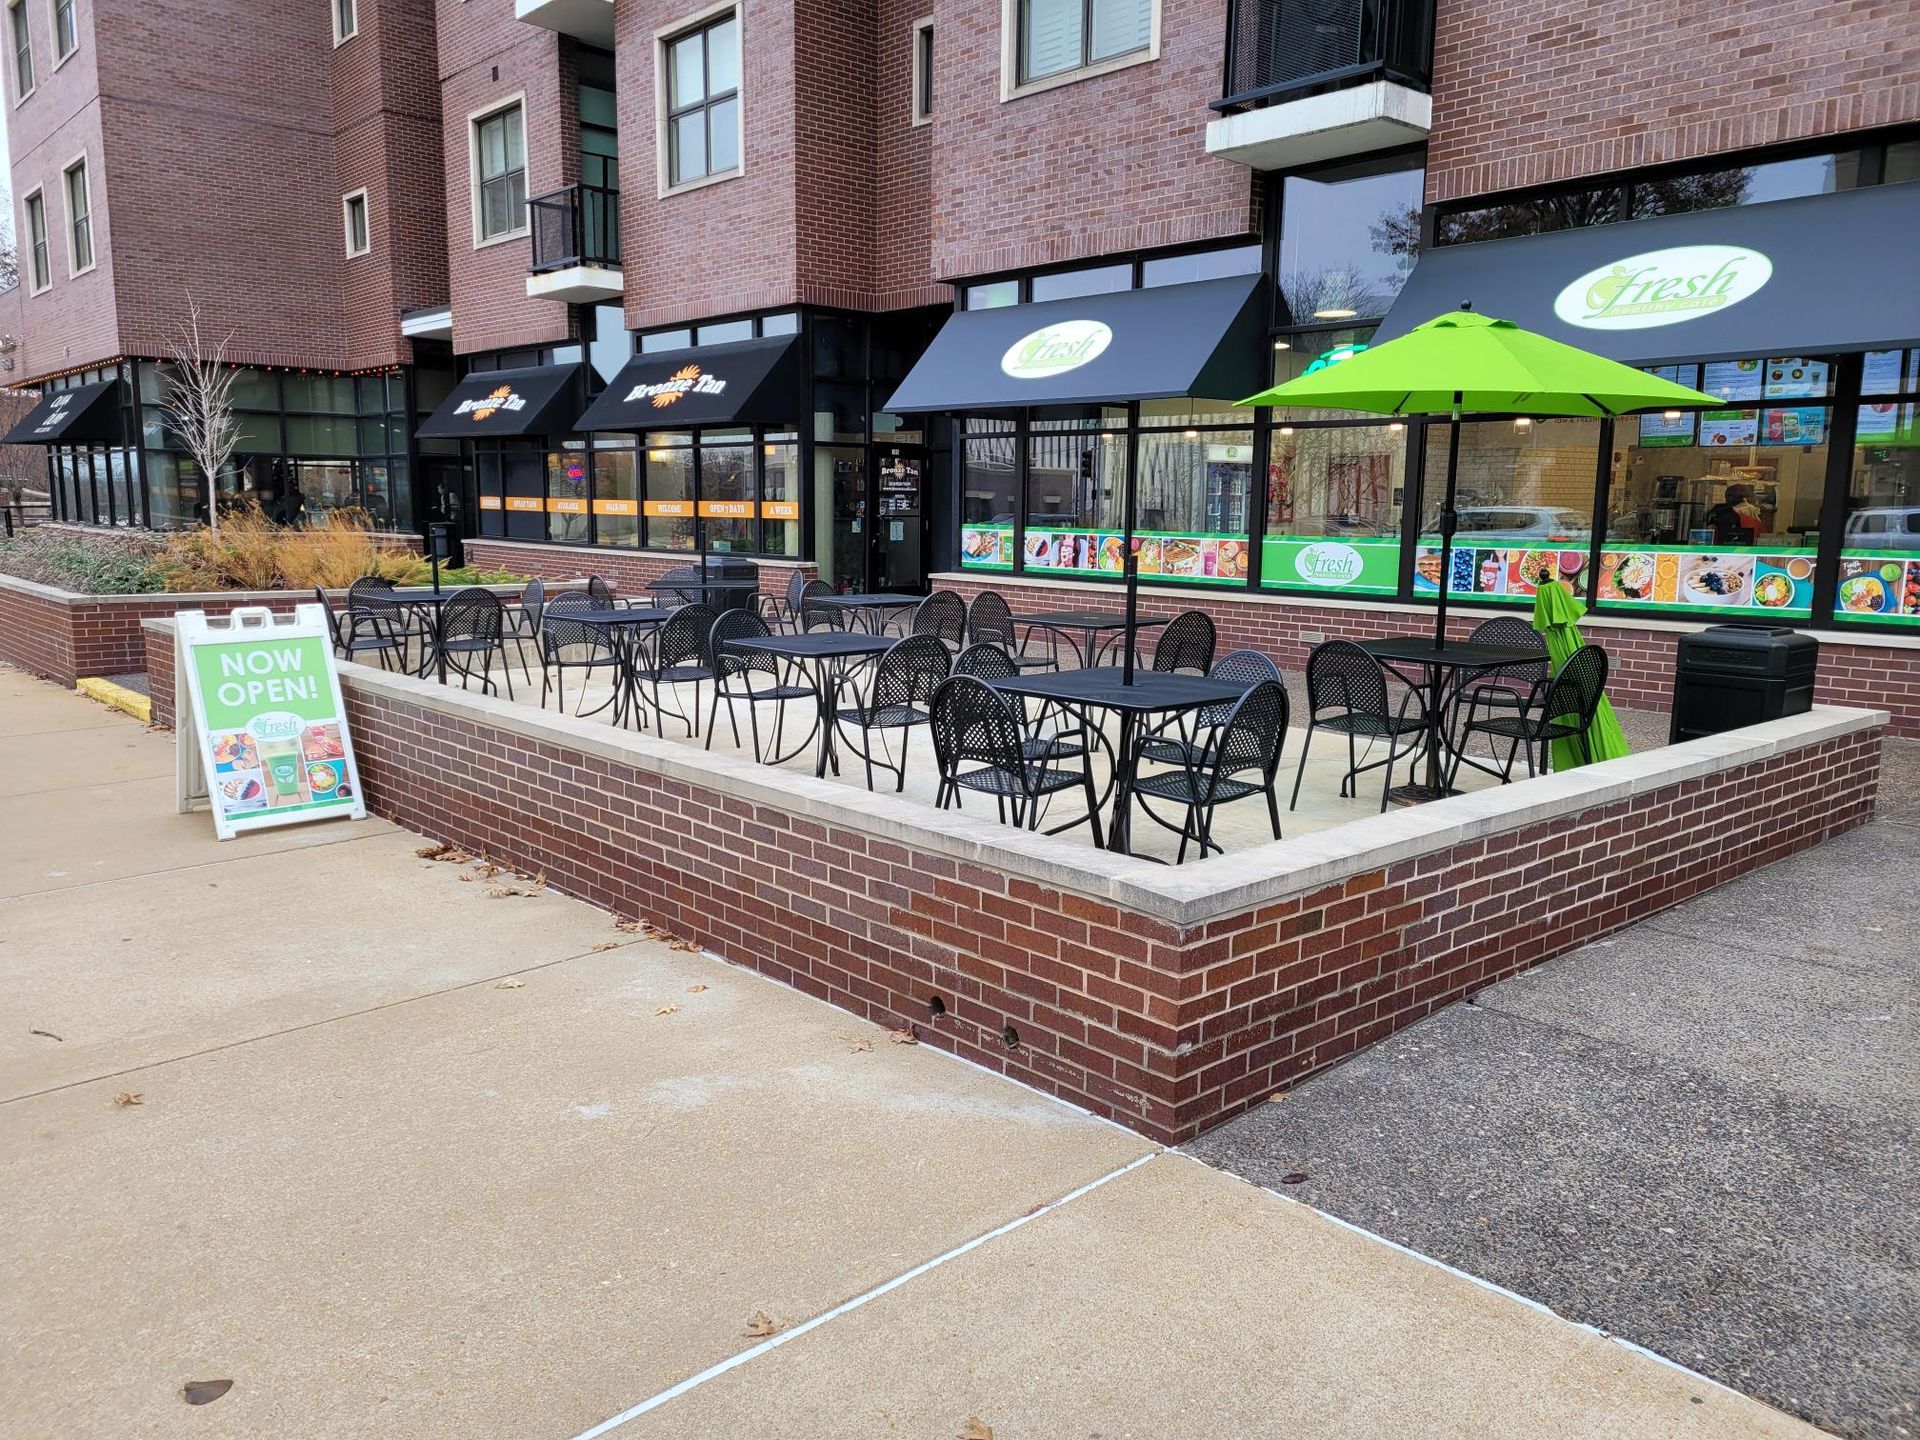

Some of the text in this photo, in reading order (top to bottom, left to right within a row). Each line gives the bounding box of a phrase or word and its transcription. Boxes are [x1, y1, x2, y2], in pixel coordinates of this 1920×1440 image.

[1582, 256, 1747, 319] fresh
[1013, 329, 1103, 370] fresh
[623, 374, 727, 402] Bronze Tan
[453, 394, 527, 415] Bronze Tan
[881, 466, 919, 476] Bronze Tan
[657, 504, 682, 513] WELCOME
[709, 504, 725, 513] OPEN
[729, 505, 745, 514] DAYS
[769, 506, 793, 516] A WEEK
[1307, 551, 1354, 577] fresh
[220, 647, 302, 677] NOW
[217, 675, 319, 707] OPEN!
[258, 716, 298, 738] fresh
